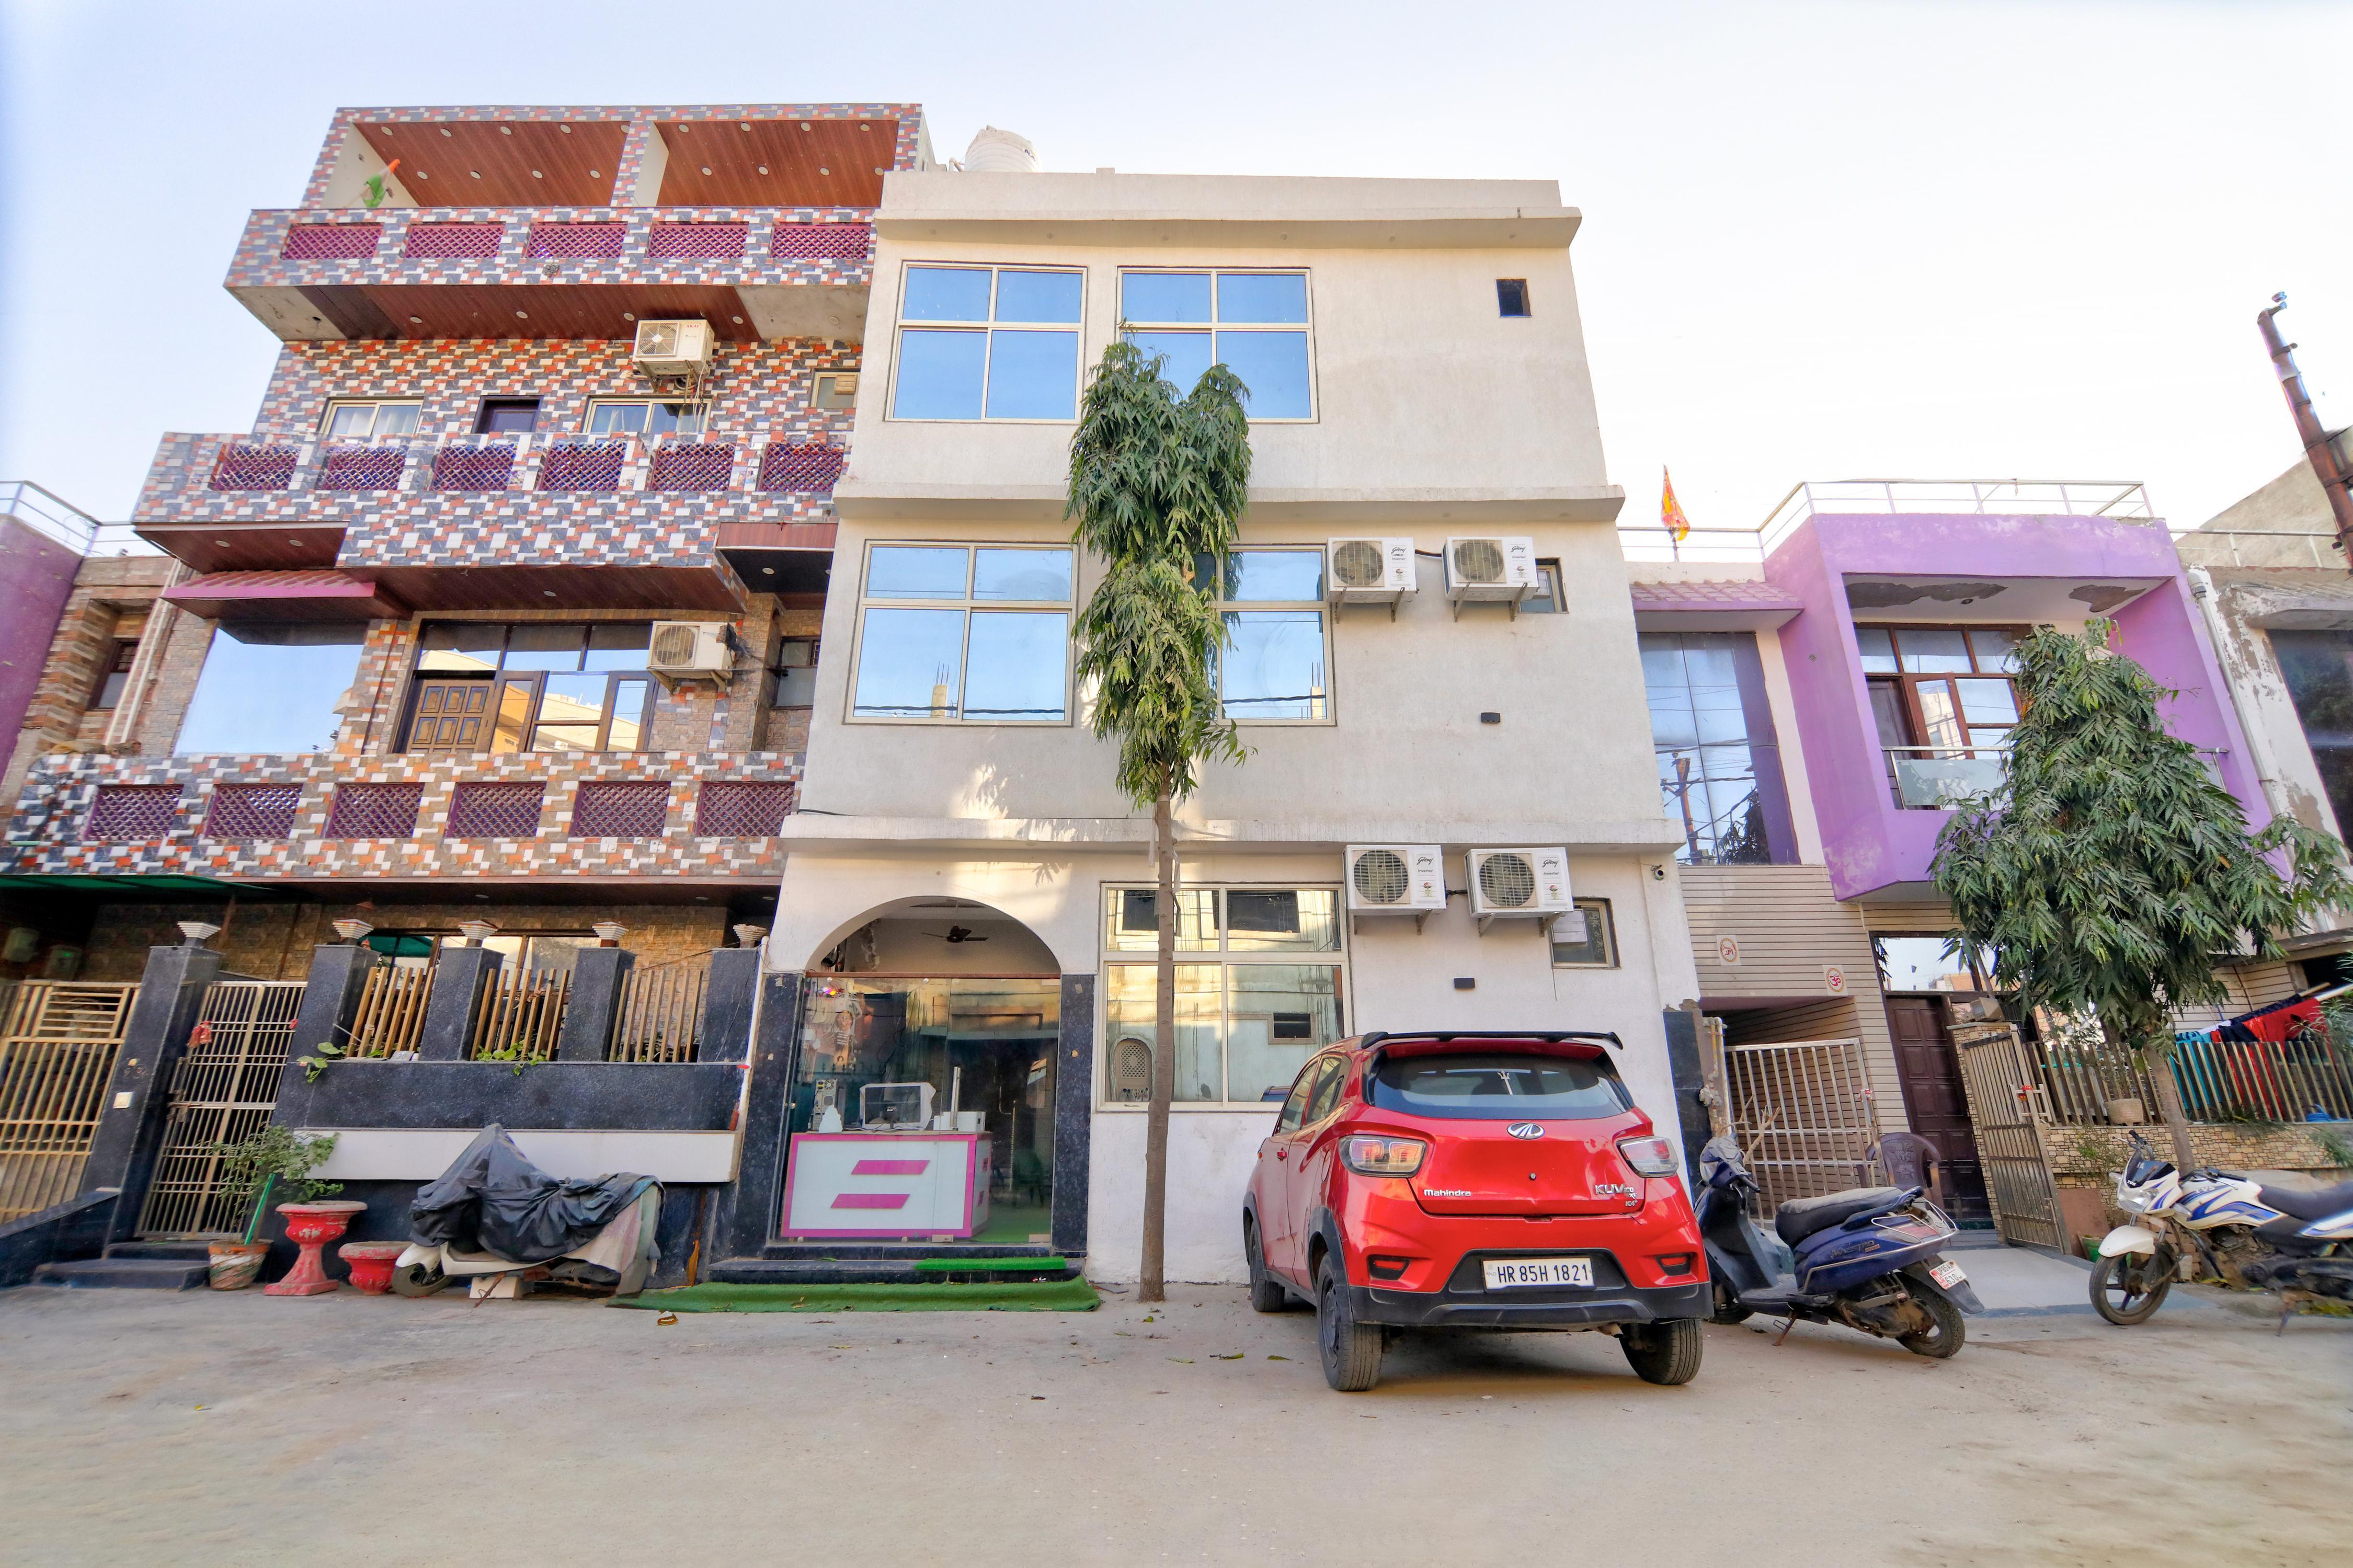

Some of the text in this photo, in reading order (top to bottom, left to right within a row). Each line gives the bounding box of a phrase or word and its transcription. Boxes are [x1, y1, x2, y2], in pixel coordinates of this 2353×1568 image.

[1498, 1264, 1588, 1283] HR 85H 1821
